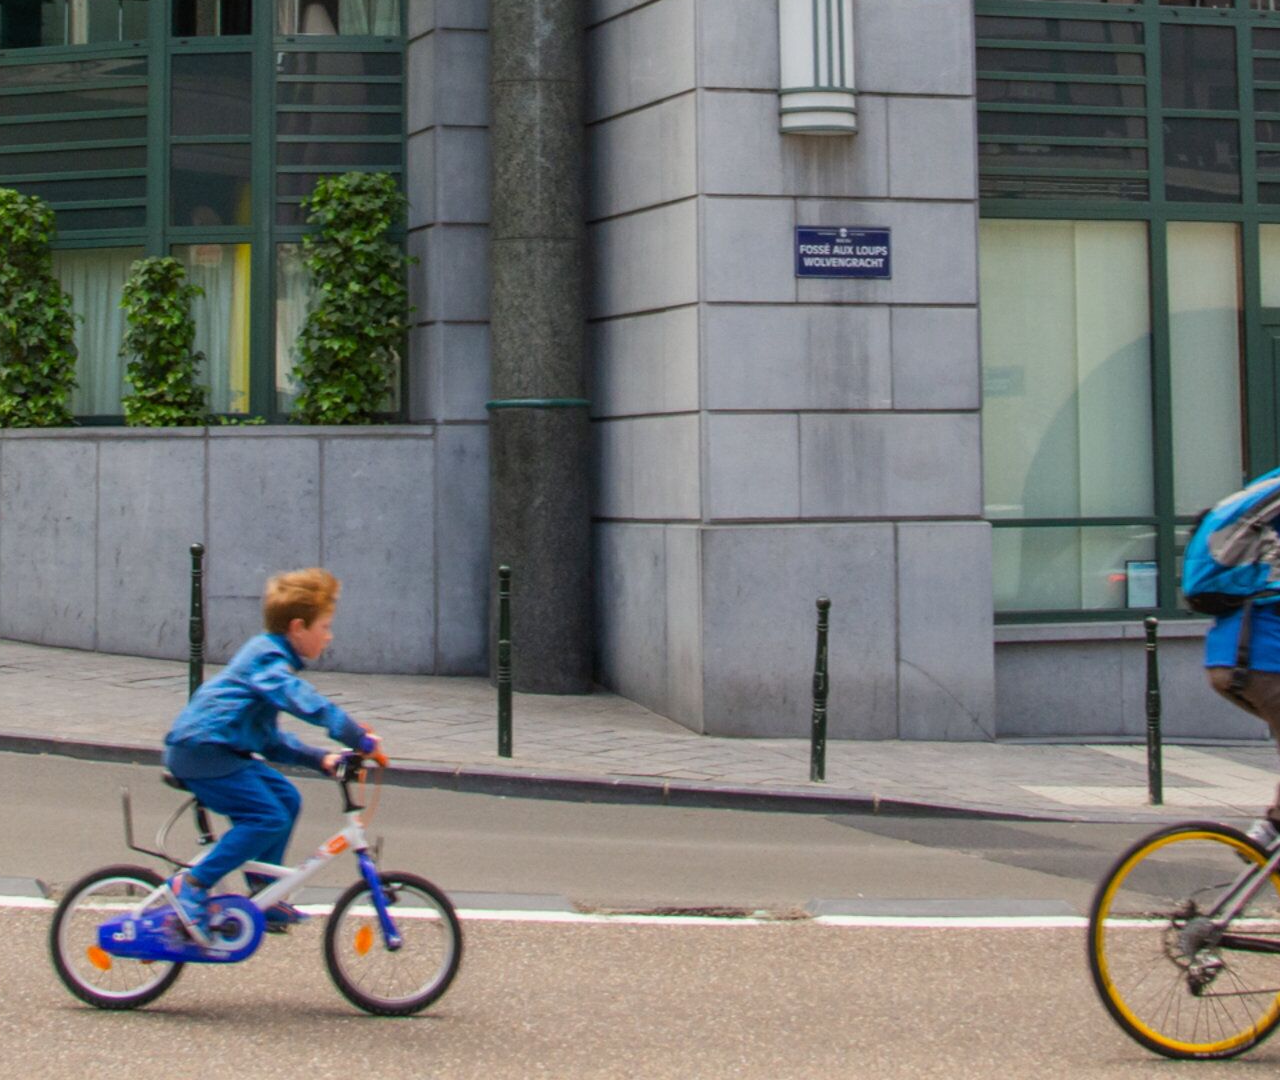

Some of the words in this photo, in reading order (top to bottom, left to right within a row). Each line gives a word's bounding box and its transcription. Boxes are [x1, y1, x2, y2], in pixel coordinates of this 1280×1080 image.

[833, 245, 854, 255] AUX
[856, 246, 888, 256] LOUPS
[803, 258, 884, 268] WOLVENGRACHT
